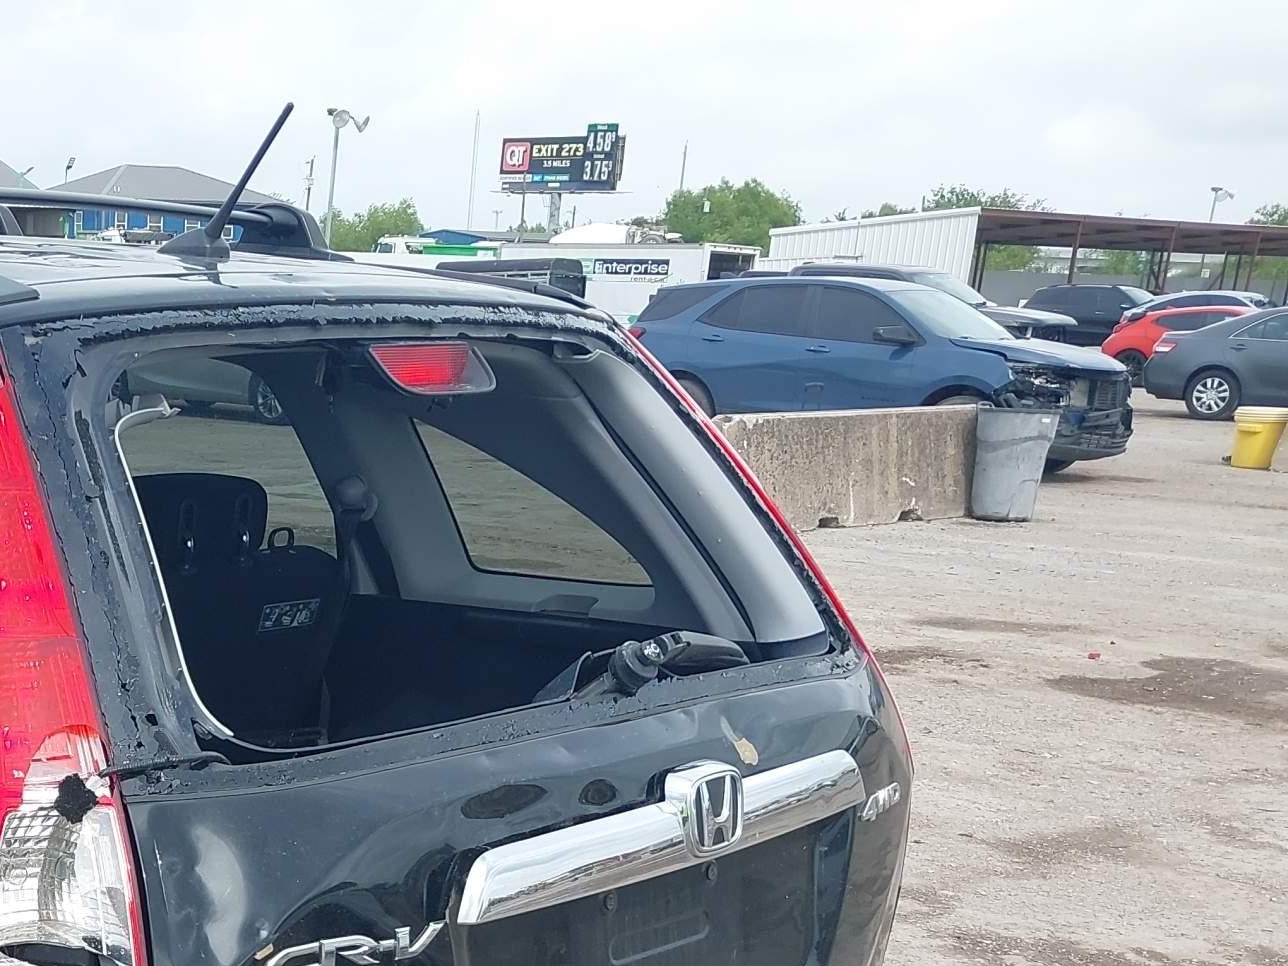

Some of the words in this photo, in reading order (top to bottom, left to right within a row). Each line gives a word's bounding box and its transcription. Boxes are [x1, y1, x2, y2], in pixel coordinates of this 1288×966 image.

[506, 145, 526, 168] QT
[532, 144, 560, 157] EXIT
[561, 143, 584, 157] 273
[552, 160, 571, 168] MILES
[594, 260, 668, 275] Enterprise
